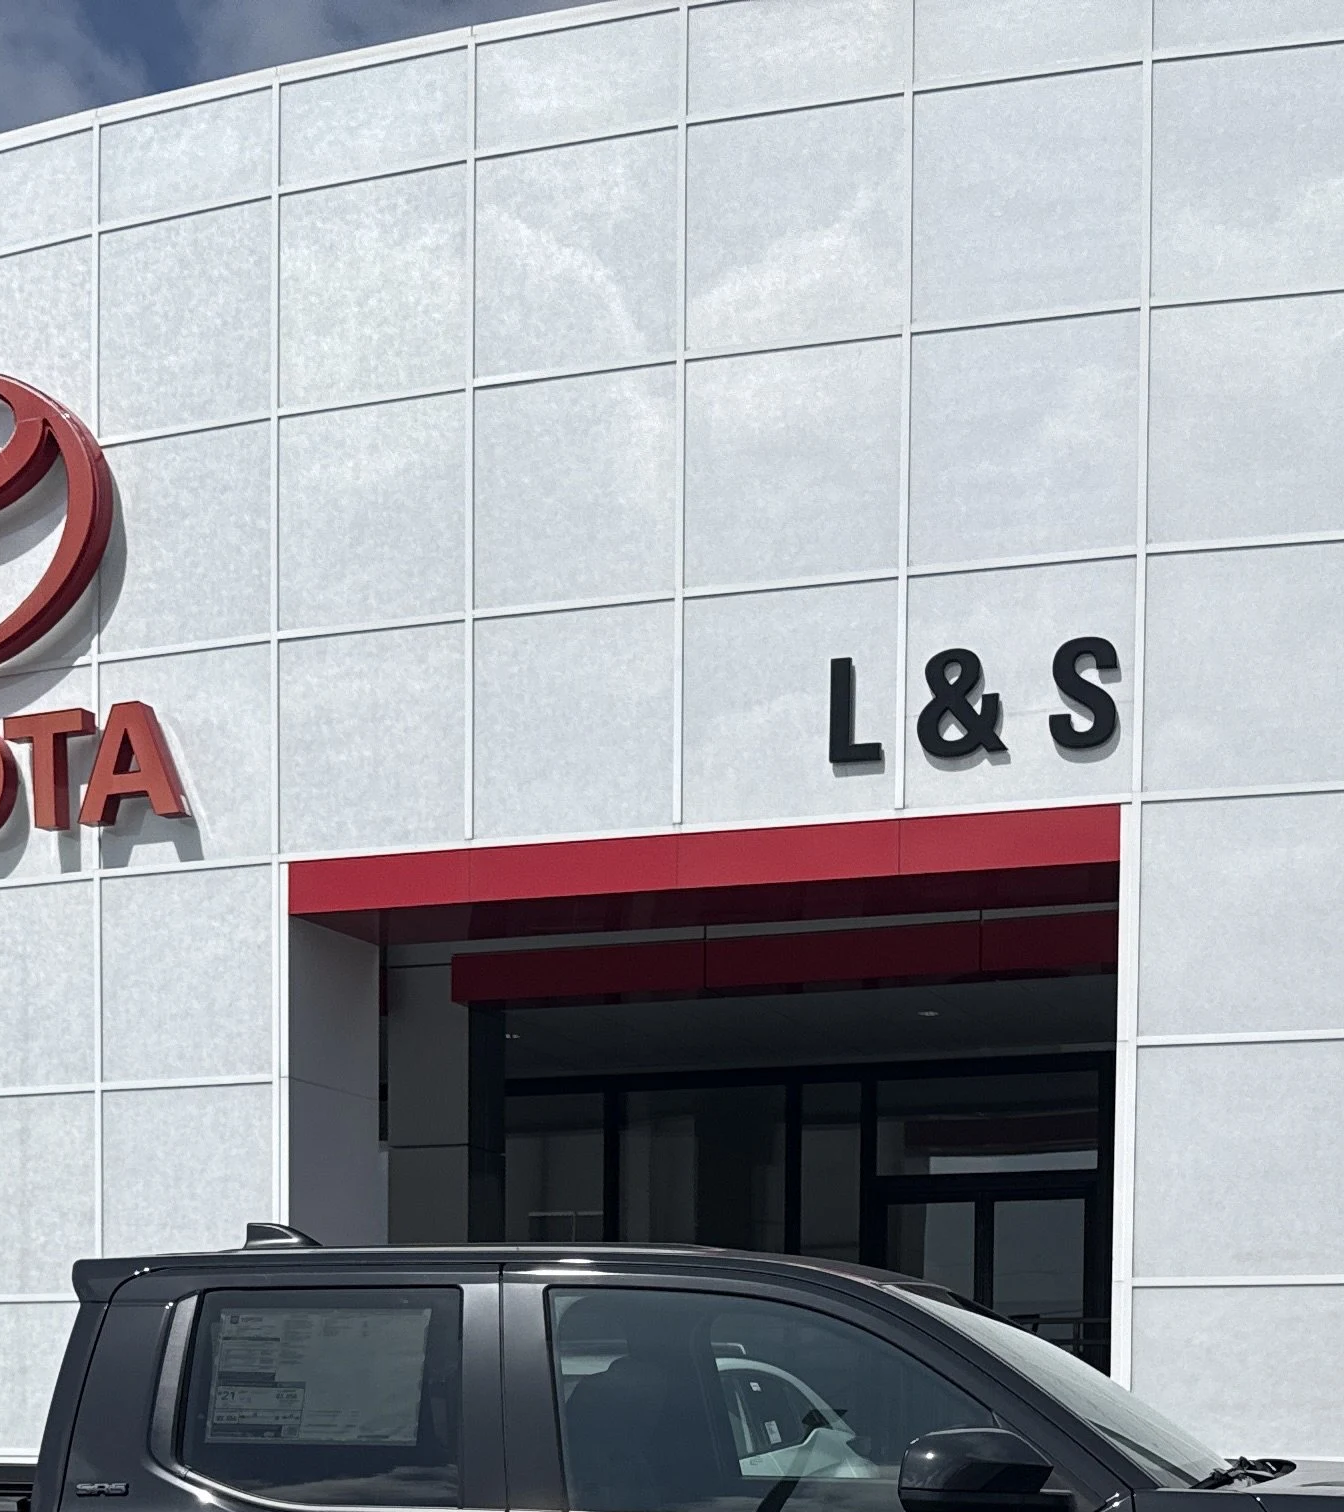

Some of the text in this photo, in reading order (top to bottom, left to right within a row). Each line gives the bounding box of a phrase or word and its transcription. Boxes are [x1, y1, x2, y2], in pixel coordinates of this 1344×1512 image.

[828, 636, 1119, 763] L & S
[76, 1482, 129, 1497] SR5
